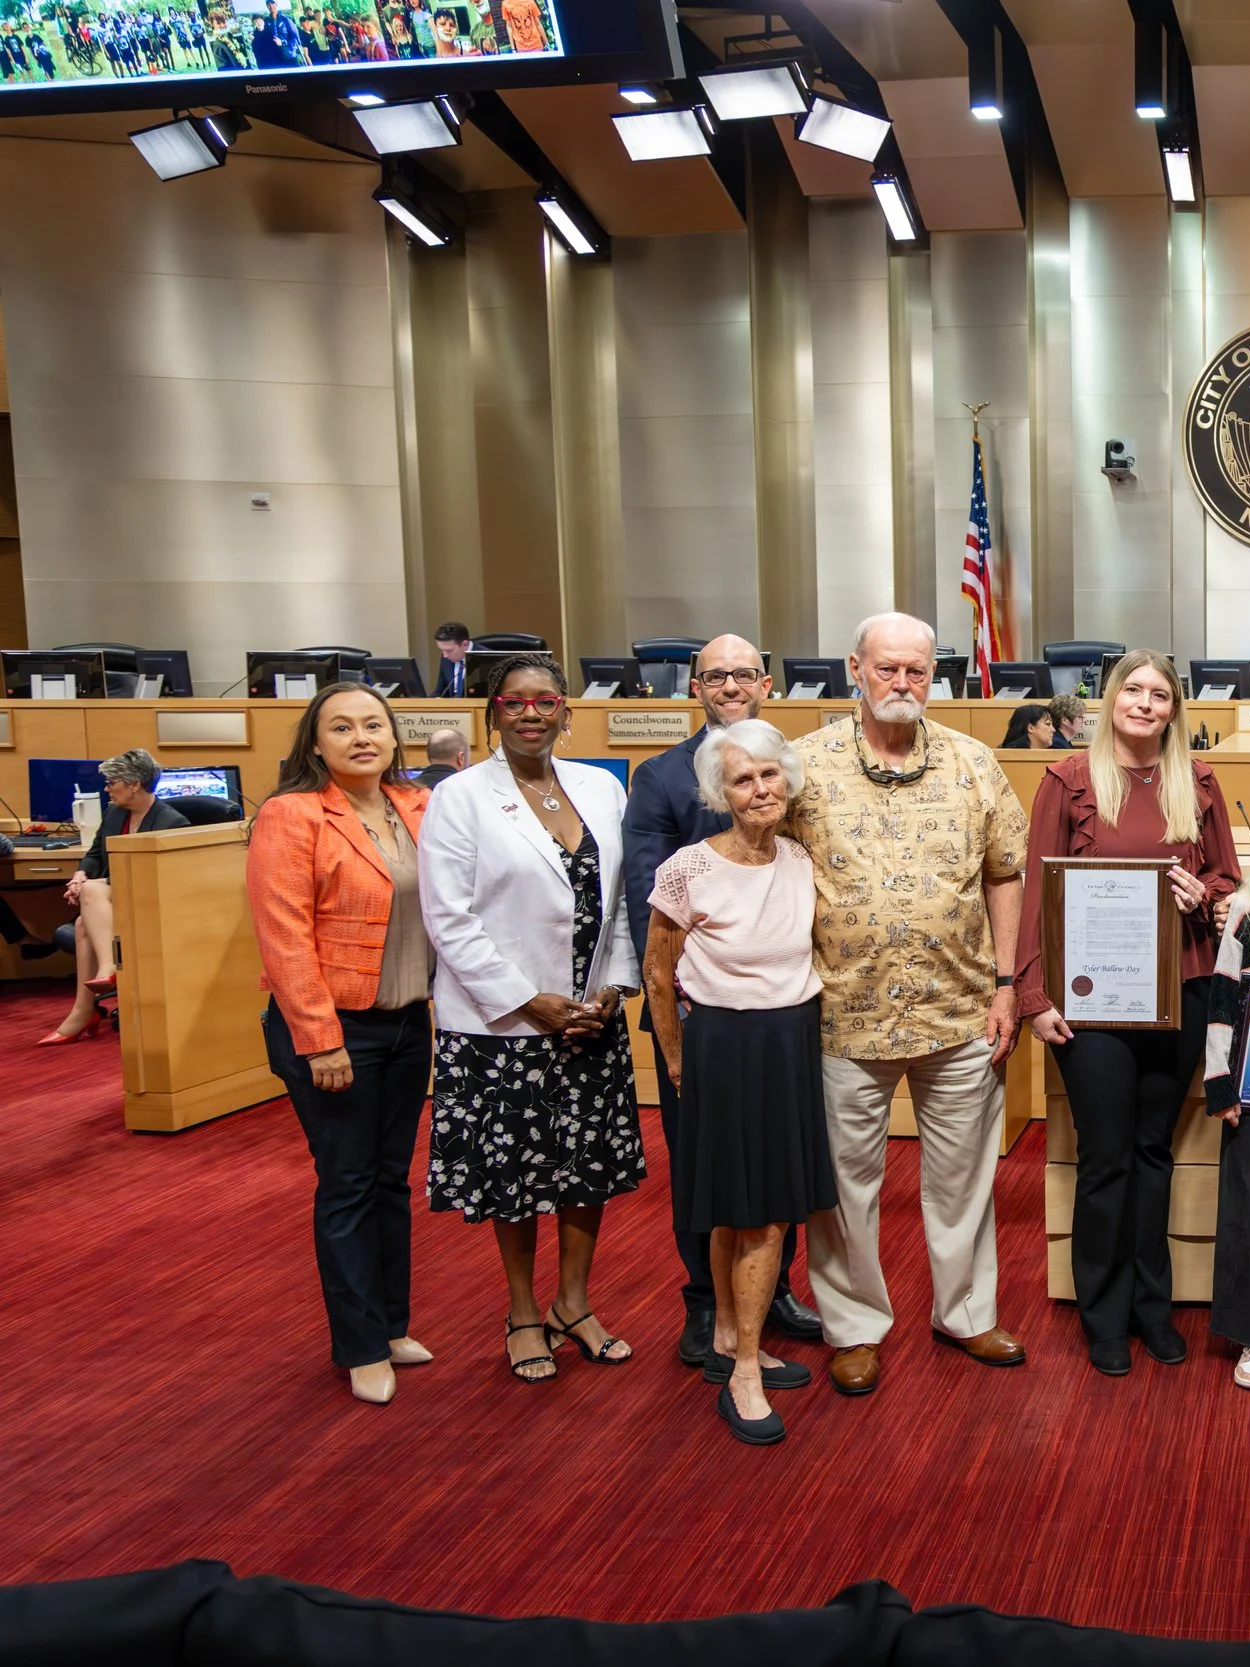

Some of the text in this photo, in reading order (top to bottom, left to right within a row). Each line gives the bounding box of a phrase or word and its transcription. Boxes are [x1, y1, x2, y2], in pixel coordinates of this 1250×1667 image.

[245, 83, 288, 94] Panasonic
[1196, 366, 1231, 429] CITY
[396, 716, 460, 727] City Attorney
[612, 714, 682, 725] Councilwoman
[608, 728, 688, 738] Summers-Armstrong
[1083, 965, 1100, 974] Tyler
[1125, 965, 1141, 975] Day
